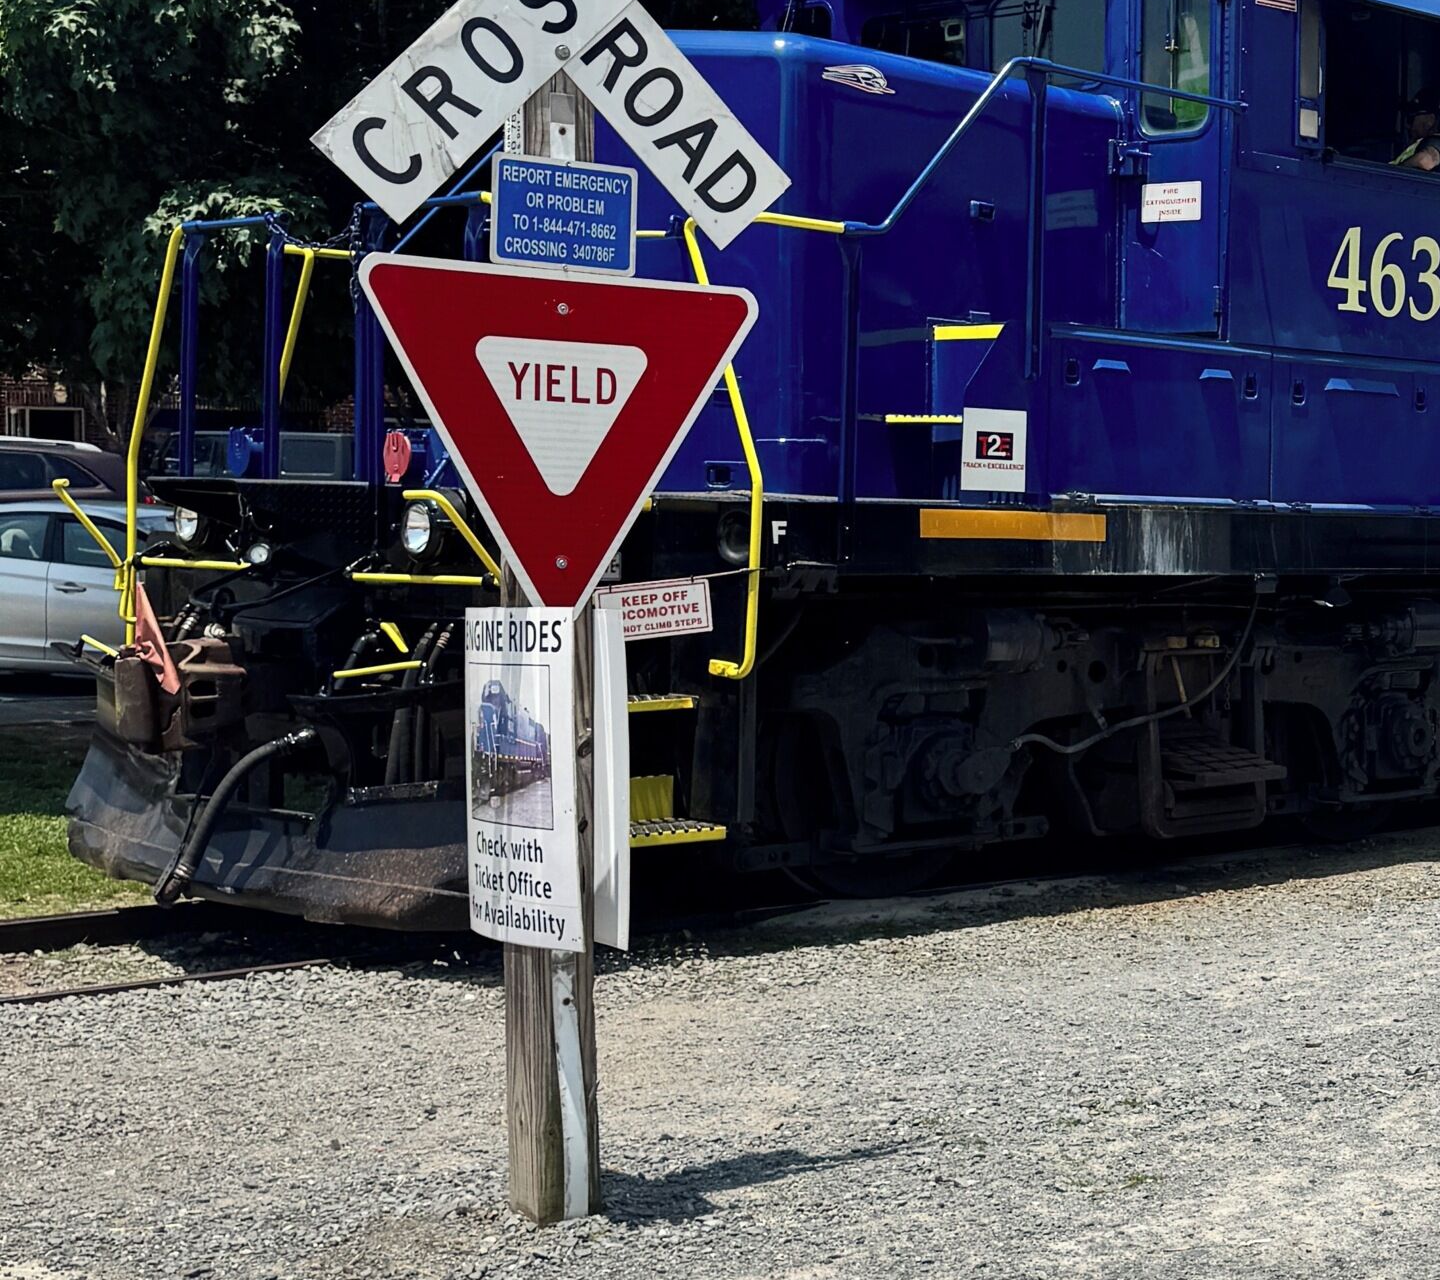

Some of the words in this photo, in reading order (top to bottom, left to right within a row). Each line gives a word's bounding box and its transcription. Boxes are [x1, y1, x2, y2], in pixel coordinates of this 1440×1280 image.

[579, 16, 757, 214] ROAD
[503, 165, 551, 185] REPORT
[556, 172, 628, 194] EMERGENCY
[526, 191, 544, 209] OR
[548, 195, 603, 215] PROBLEM
[513, 214, 529, 230] TO
[533, 216, 616, 239] 1-844-471-8662
[505, 237, 566, 257] CROSSING
[573, 244, 615, 261] 340786F
[507, 361, 617, 405] YIELD
[771, 520, 788, 545] F
[621, 593, 658, 607] KEEP
[662, 590, 688, 603] OFF
[623, 603, 699, 619] COMOTIVE
[508, 620, 562, 653] RIDES
[623, 624, 642, 633] NOT
[644, 621, 672, 631] CLIMB
[674, 617, 703, 627] STEPS
[476, 831, 508, 859] Check
[511, 838, 543, 863] with
[474, 863, 505, 892] Ticket
[507, 870, 552, 899] Office
[484, 901, 566, 941] Availability
